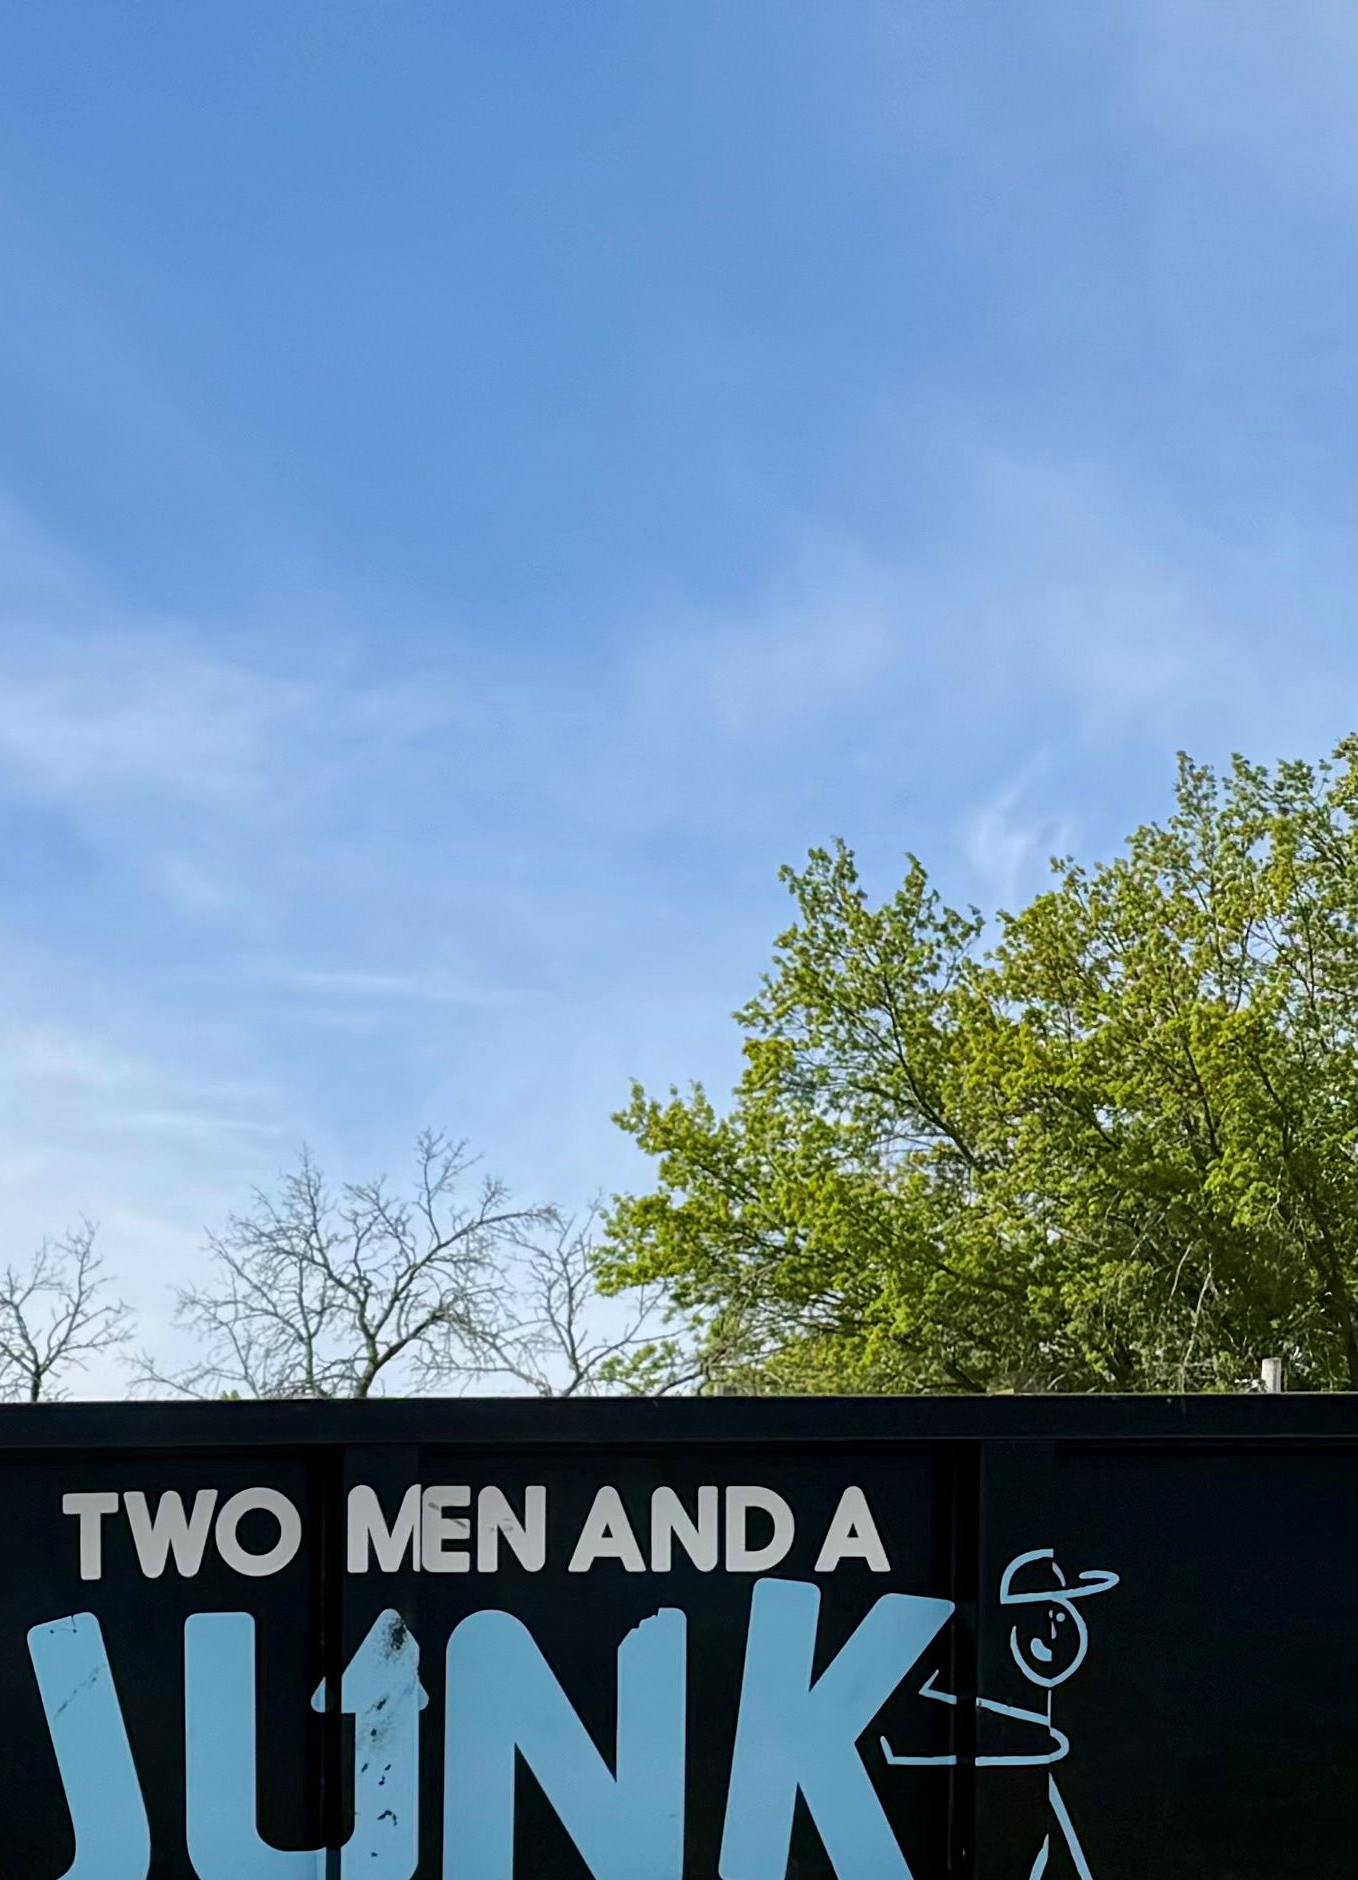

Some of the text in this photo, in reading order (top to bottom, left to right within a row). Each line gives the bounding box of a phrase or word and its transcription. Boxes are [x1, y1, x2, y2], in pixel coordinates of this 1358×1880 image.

[62, 1484, 892, 1580] TWO MEN AND A
